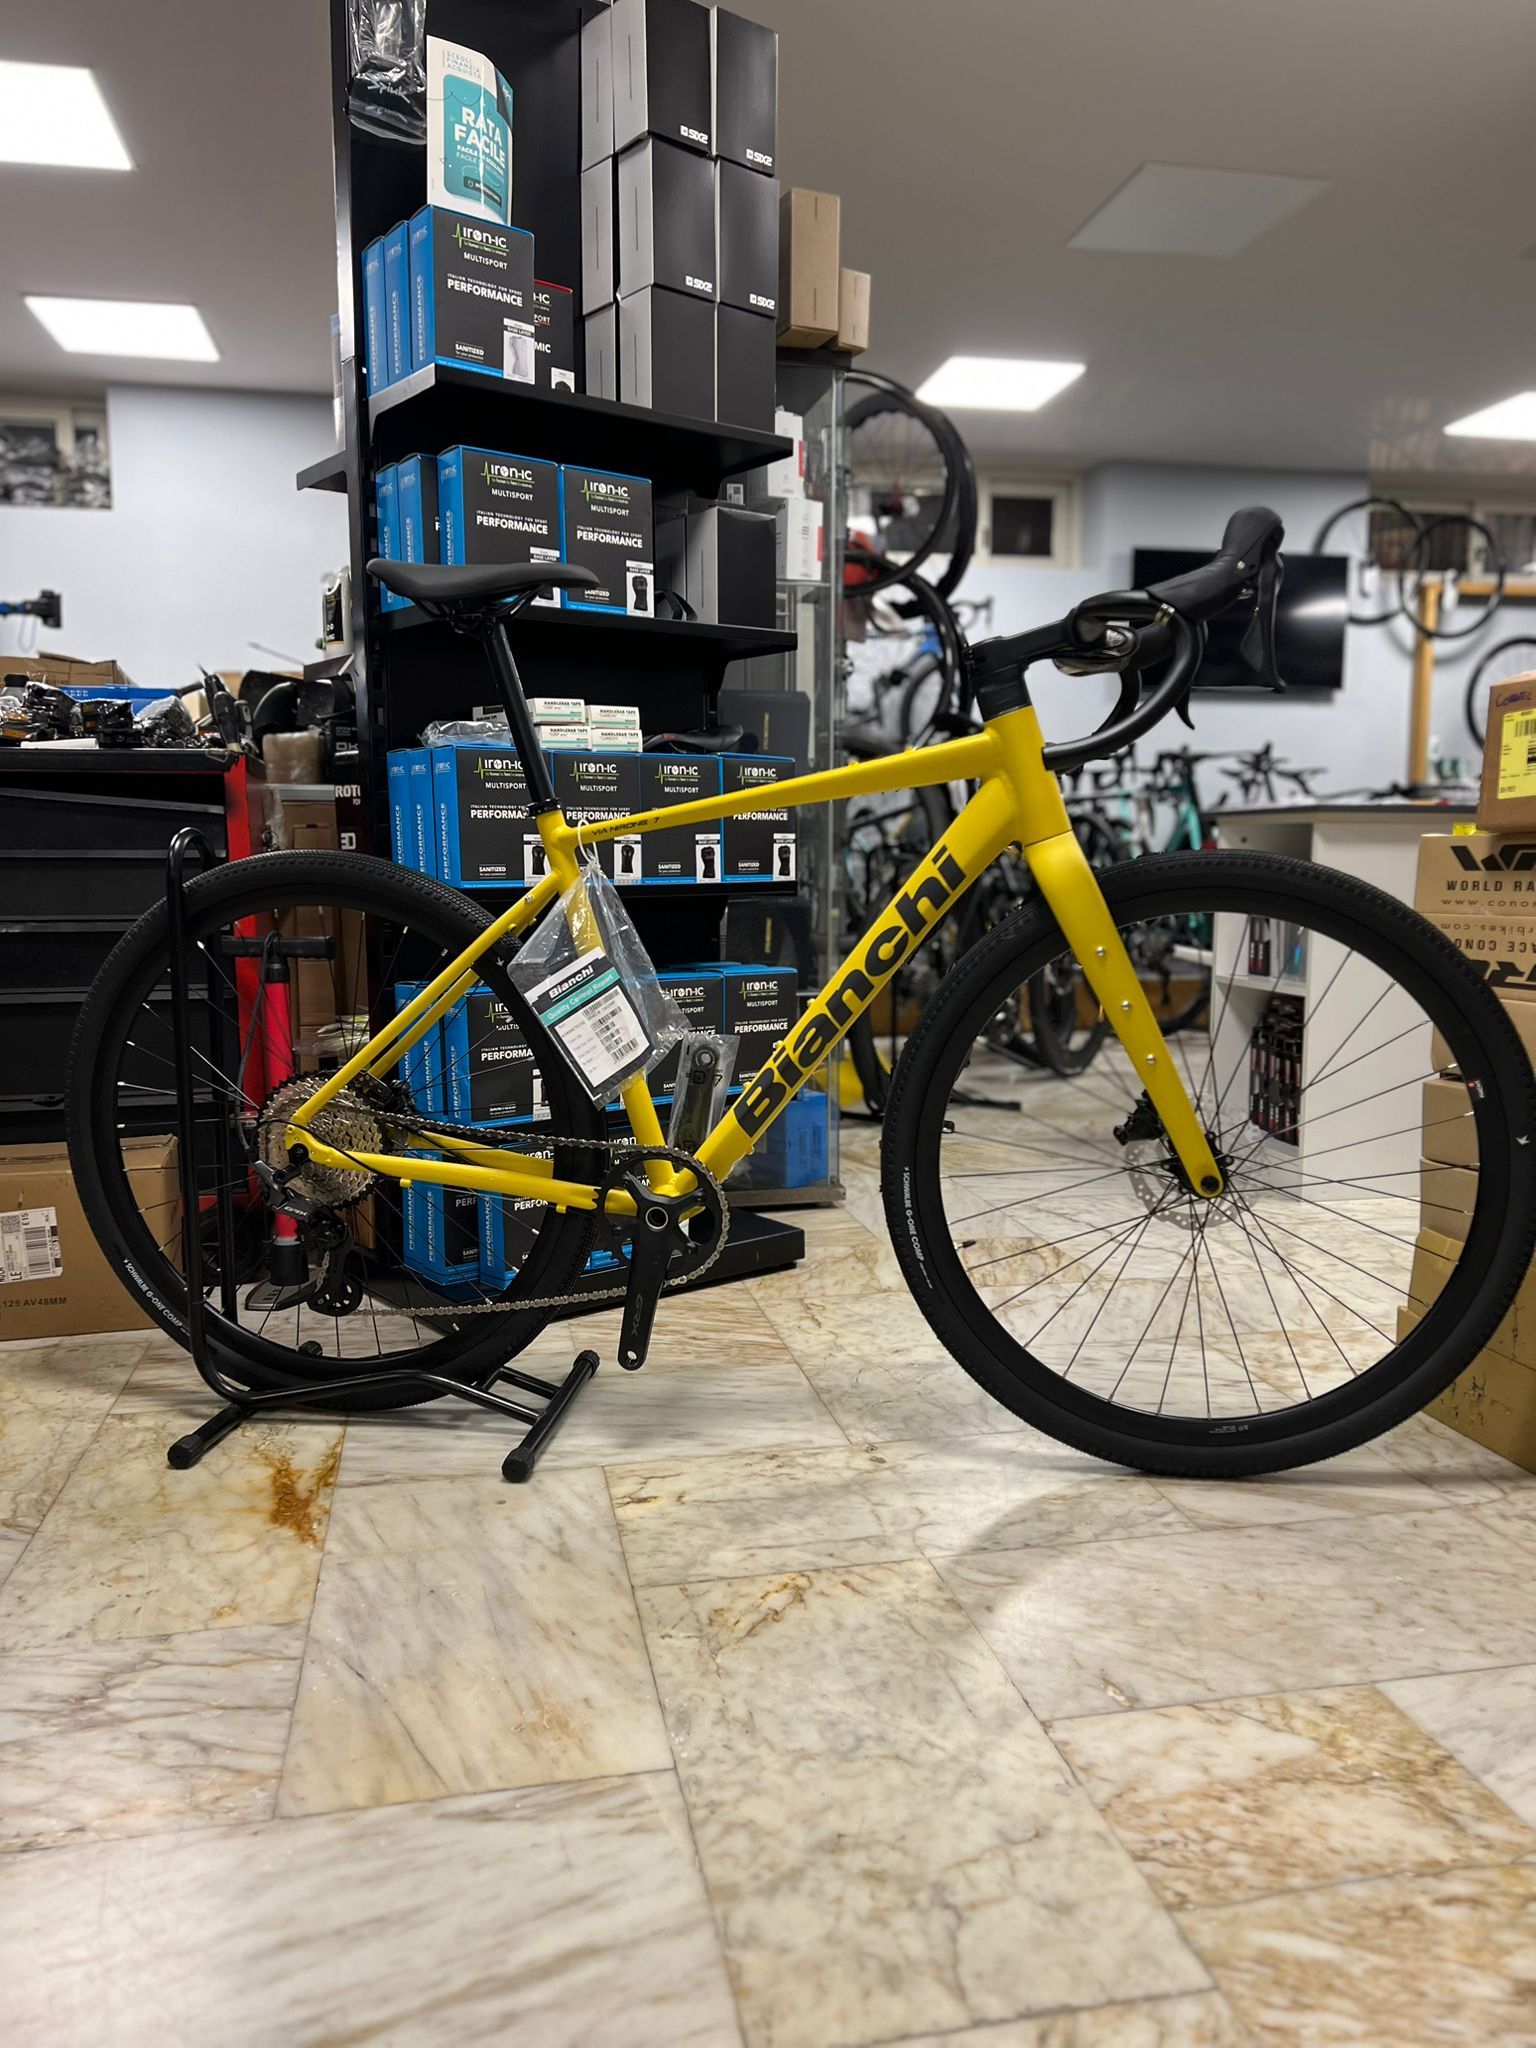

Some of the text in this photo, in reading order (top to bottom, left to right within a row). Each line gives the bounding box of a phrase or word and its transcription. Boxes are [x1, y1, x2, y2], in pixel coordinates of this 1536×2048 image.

[461, 106, 503, 147] RATA
[454, 124, 506, 169] FACILE
[463, 252, 508, 270] MULTISPORT
[447, 278, 523, 307] PERFORMANCE
[455, 343, 485, 357] SANITIZED
[491, 488, 534, 501] MULTISPORT
[590, 504, 630, 517] MULTISPORT
[476, 515, 549, 535] PERFORMANCE
[576, 530, 643, 549] PERFORMANCE
[485, 782, 527, 790] MULTISPORT
[470, 810, 527, 819] PERFORMA
[732, 812, 788, 821] PERFORMANCE
[591, 816, 661, 836] VIA NIRONE 7
[1446, 880, 1503, 892] WORLD
[1454, 938, 1497, 952] CONO
[548, 965, 595, 999] Bianchi
[547, 973, 615, 1020] Quality Control Report
[733, 845, 967, 1138] Bianchi
[746, 1000, 778, 1008] MULTISPORT
[734, 1022, 789, 1034] PERFORMANCE
[481, 1048, 534, 1061] PERFORMA
[514, 1199, 549, 1211] PERFOR
[911, 1236, 925, 1262] COMP
[125, 1262, 184, 1327] SCHWALBE G-ONE COMP
